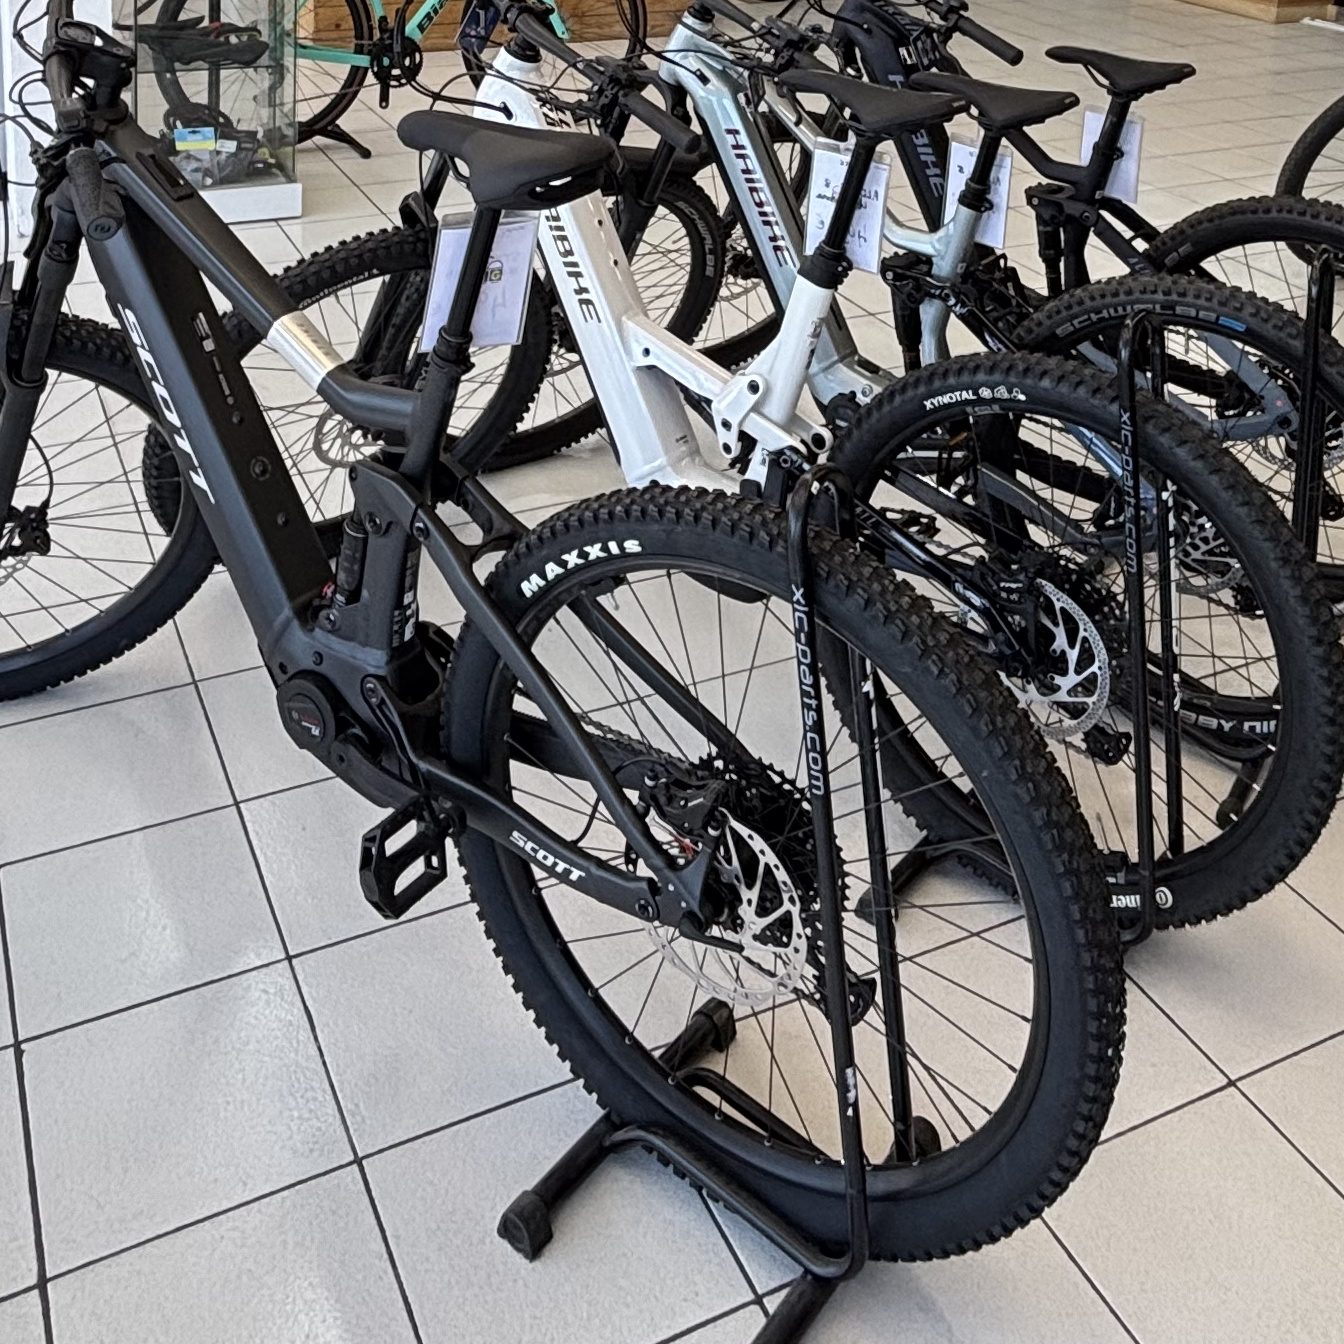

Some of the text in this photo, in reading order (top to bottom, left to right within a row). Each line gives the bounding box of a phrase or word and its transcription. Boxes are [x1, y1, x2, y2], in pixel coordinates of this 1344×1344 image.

[724, 128, 797, 268] HAIBIKE
[116, 302, 216, 505] SCOTT
[923, 389, 977, 411] XYNOTAL
[520, 537, 644, 600] MAXXIS
[790, 583, 826, 797] xlc-parts.com
[508, 829, 587, 882] SCOTT
